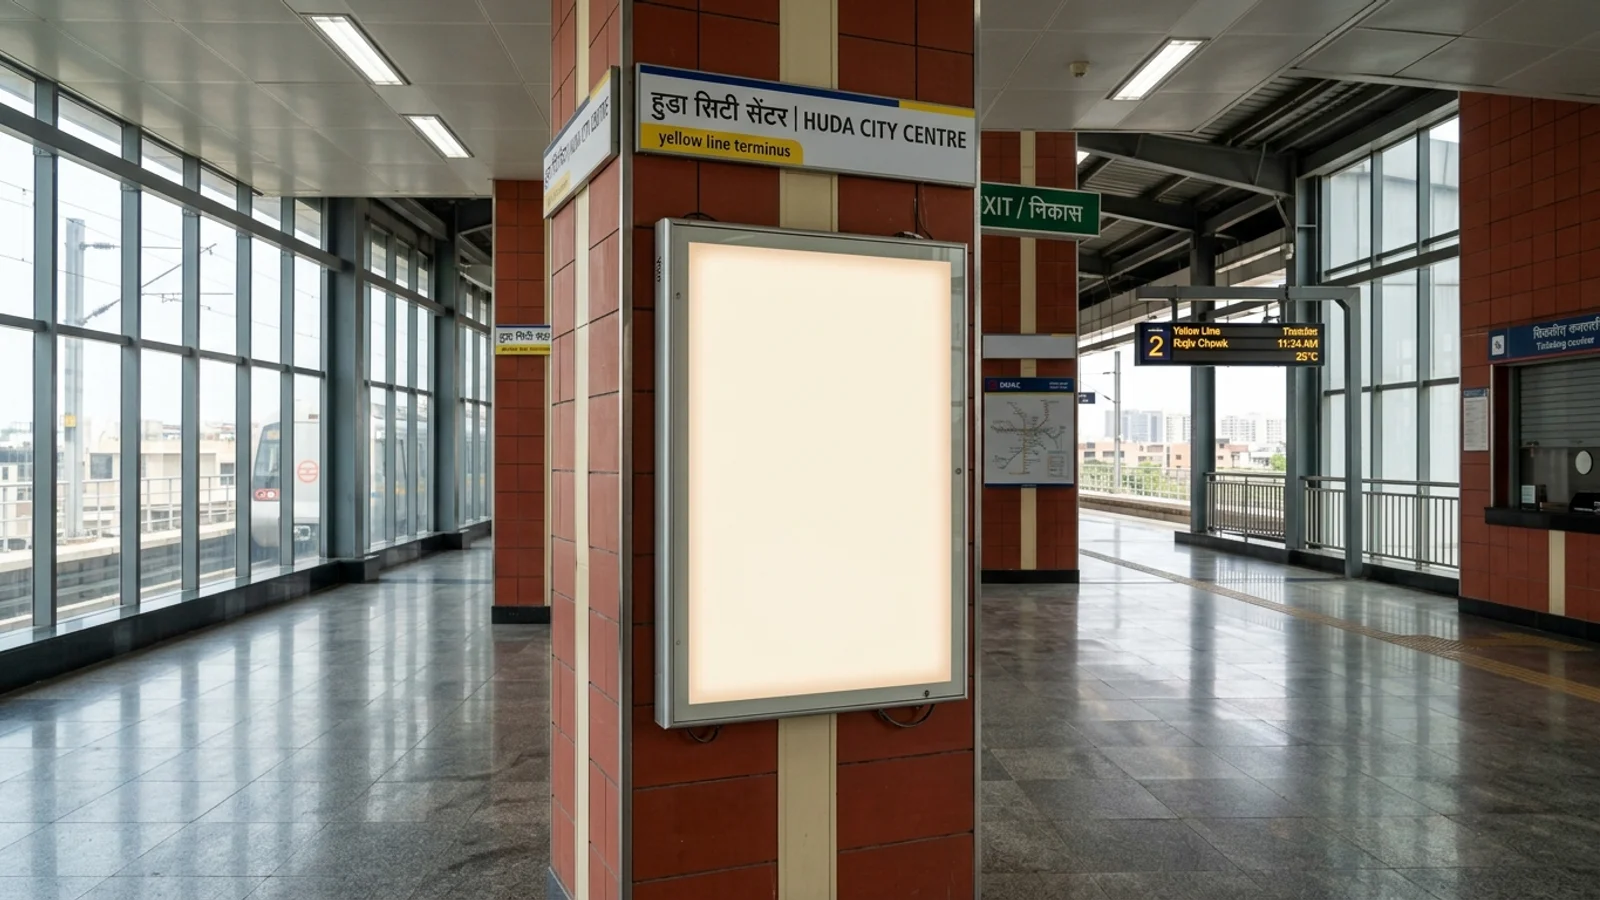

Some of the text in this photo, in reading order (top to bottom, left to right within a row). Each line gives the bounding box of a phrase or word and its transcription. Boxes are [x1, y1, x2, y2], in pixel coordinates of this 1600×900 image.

[651, 91, 967, 149] हुडा सिटी सेंटर HUDA CITY CENTRE
[659, 131, 791, 157] yellow line terminus
[981, 195, 1013, 216] XIT
[1028, 195, 1084, 222] निकास
[1149, 336, 1163, 356] 2
